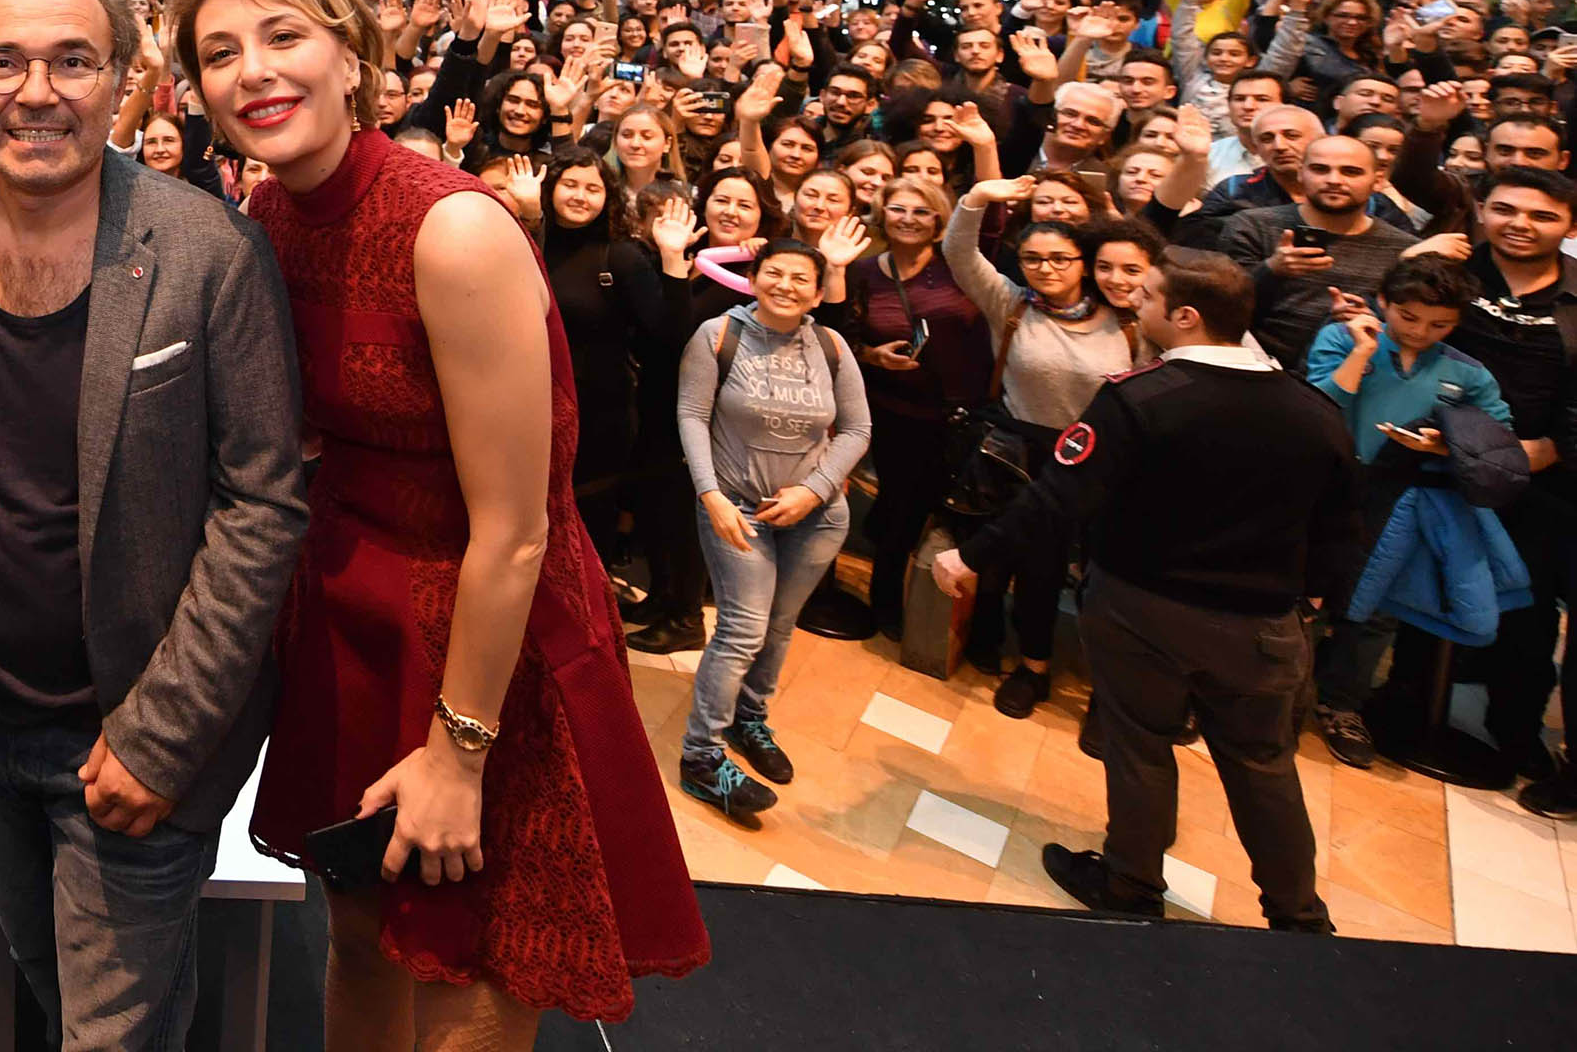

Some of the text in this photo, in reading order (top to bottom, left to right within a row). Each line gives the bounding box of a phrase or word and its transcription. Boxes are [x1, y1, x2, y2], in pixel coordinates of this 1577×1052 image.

[775, 386, 823, 407] MUCH
[763, 414, 813, 434] TO SEE
